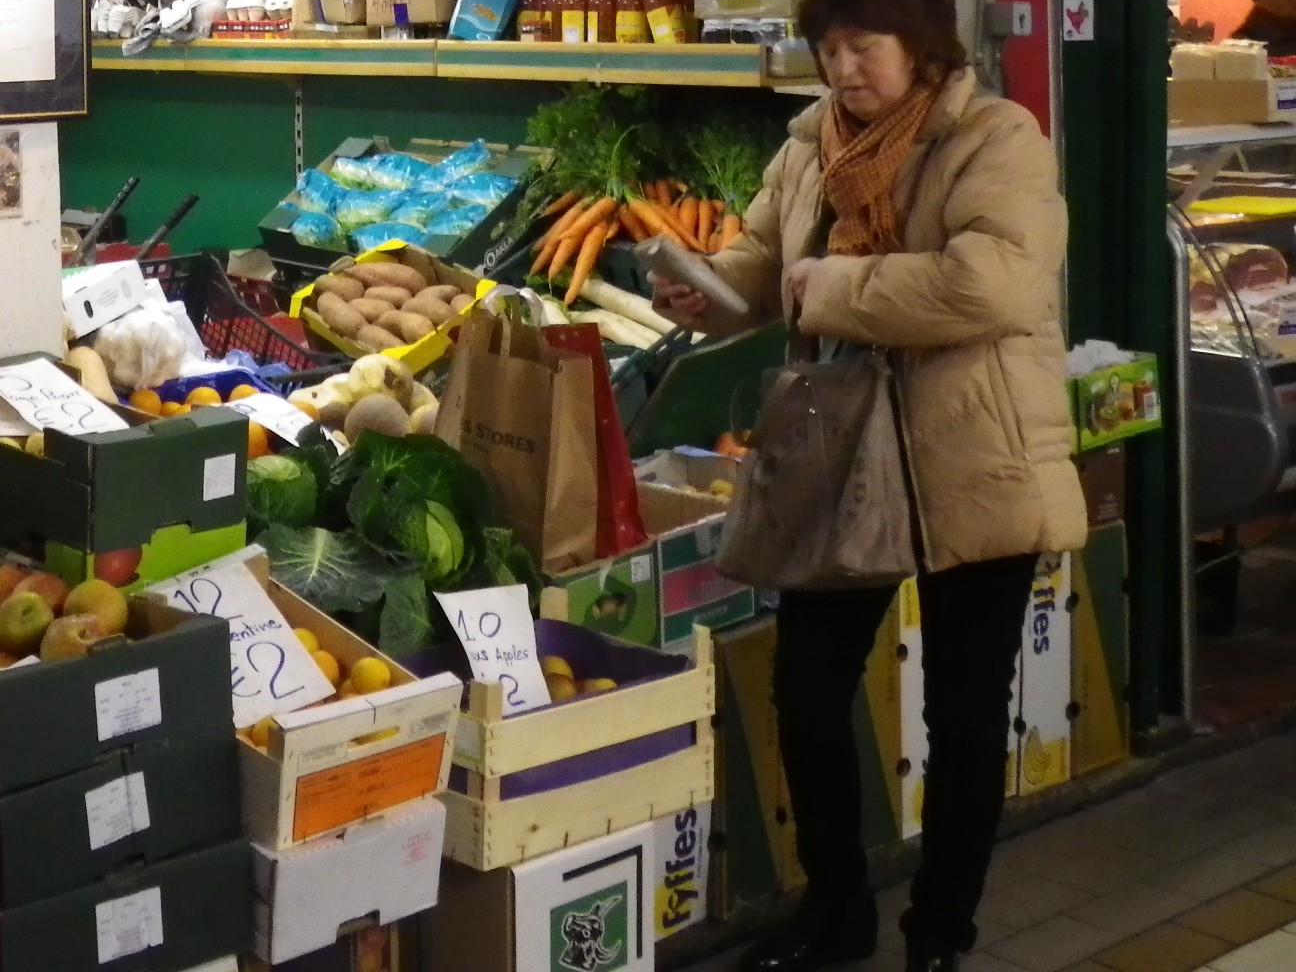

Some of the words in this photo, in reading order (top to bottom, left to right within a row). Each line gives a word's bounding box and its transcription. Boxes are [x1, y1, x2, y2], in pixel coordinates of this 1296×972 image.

[475, 421, 536, 455] STORES
[458, 609, 501, 641] 10
[495, 645, 529, 667] Apples
[661, 807, 699, 931] Fyffes
